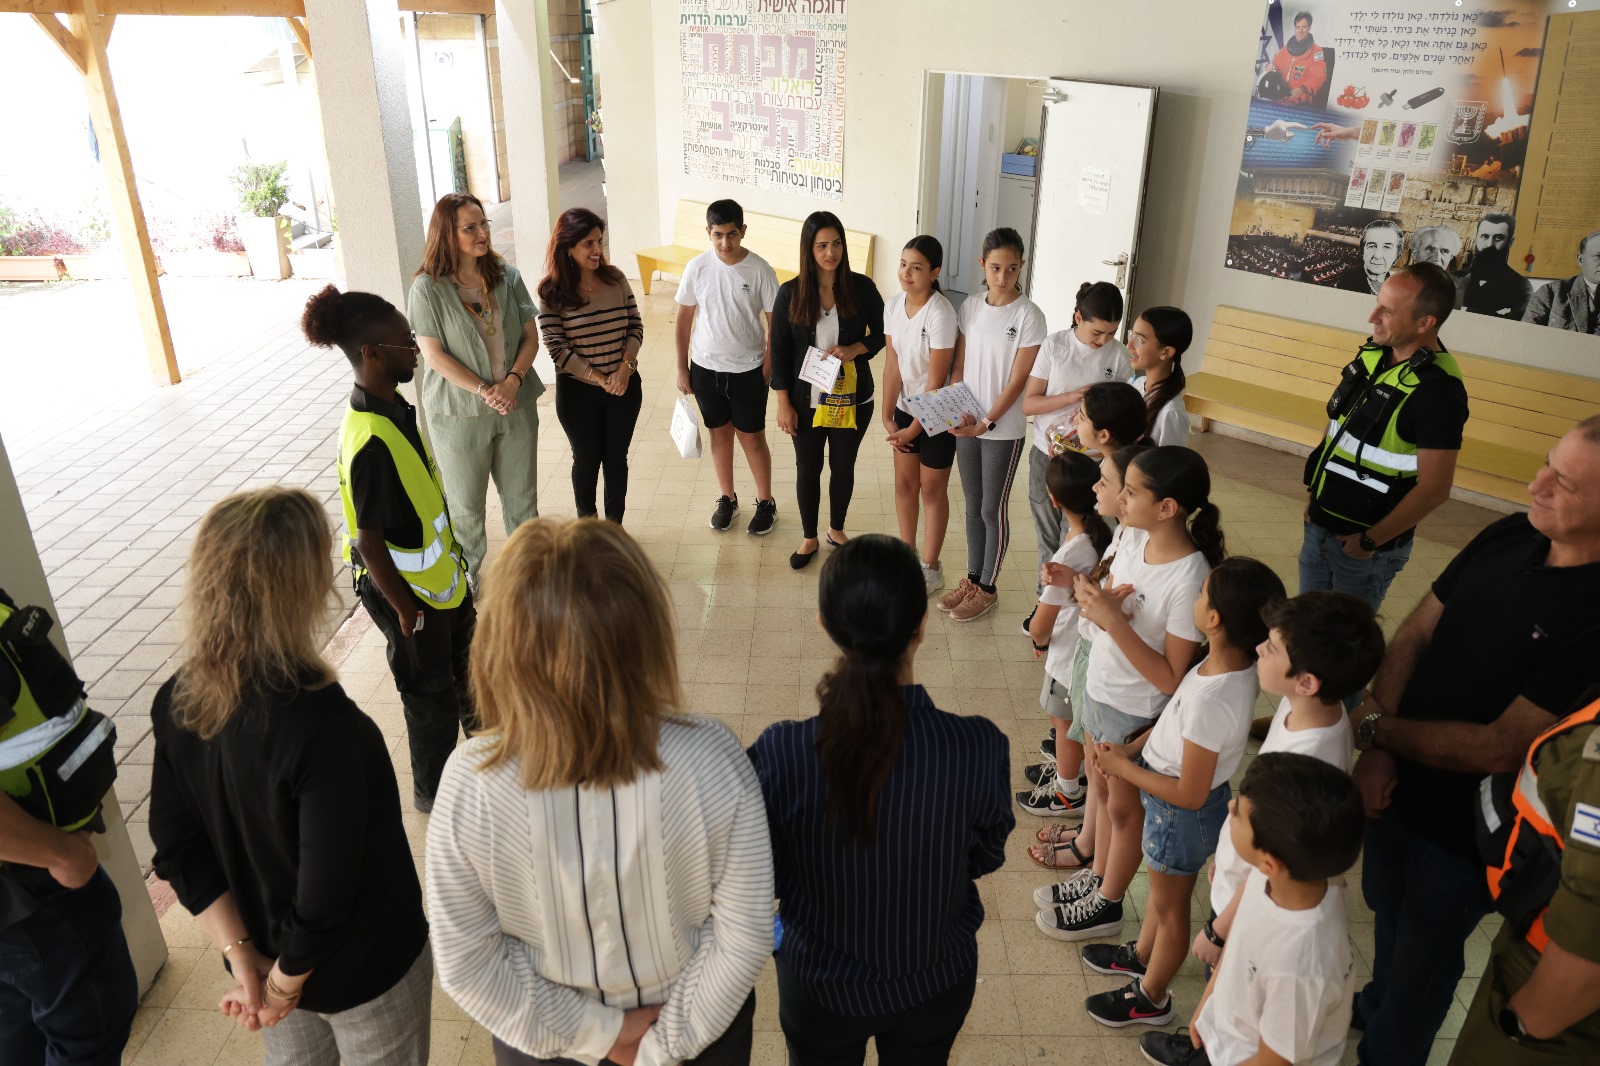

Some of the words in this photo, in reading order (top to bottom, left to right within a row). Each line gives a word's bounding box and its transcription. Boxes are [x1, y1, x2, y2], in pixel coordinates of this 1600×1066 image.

[757, 0, 798, 13] אישית
[801, 0, 847, 14] דוגמה
[680, 13, 711, 25] הדדית
[714, 14, 748, 26] ערבות
[819, 39, 847, 48] אחריות
[702, 32, 816, 81] מפתח
[815, 47, 834, 55] נתינה
[814, 54, 824, 97] חמלה
[770, 76, 815, 97] דיאלוג
[836, 49, 847, 122] והשתתפות
[687, 86, 718, 100] הדדית
[721, 88, 755, 104] ערבות
[762, 93, 784, 106] צוות
[787, 95, 822, 110] עבודת
[700, 121, 723, 130] אנושיות
[730, 121, 769, 132] אינטרקציה
[687, 143, 723, 157] והשתתפות
[833, 126, 845, 163] שיתוף
[725, 149, 746, 160] שיתוף
[754, 158, 781, 170] סבלנות
[794, 158, 842, 179] אנושיות
[771, 170, 808, 188] ובטיחות
[811, 176, 842, 193] ביטחון
